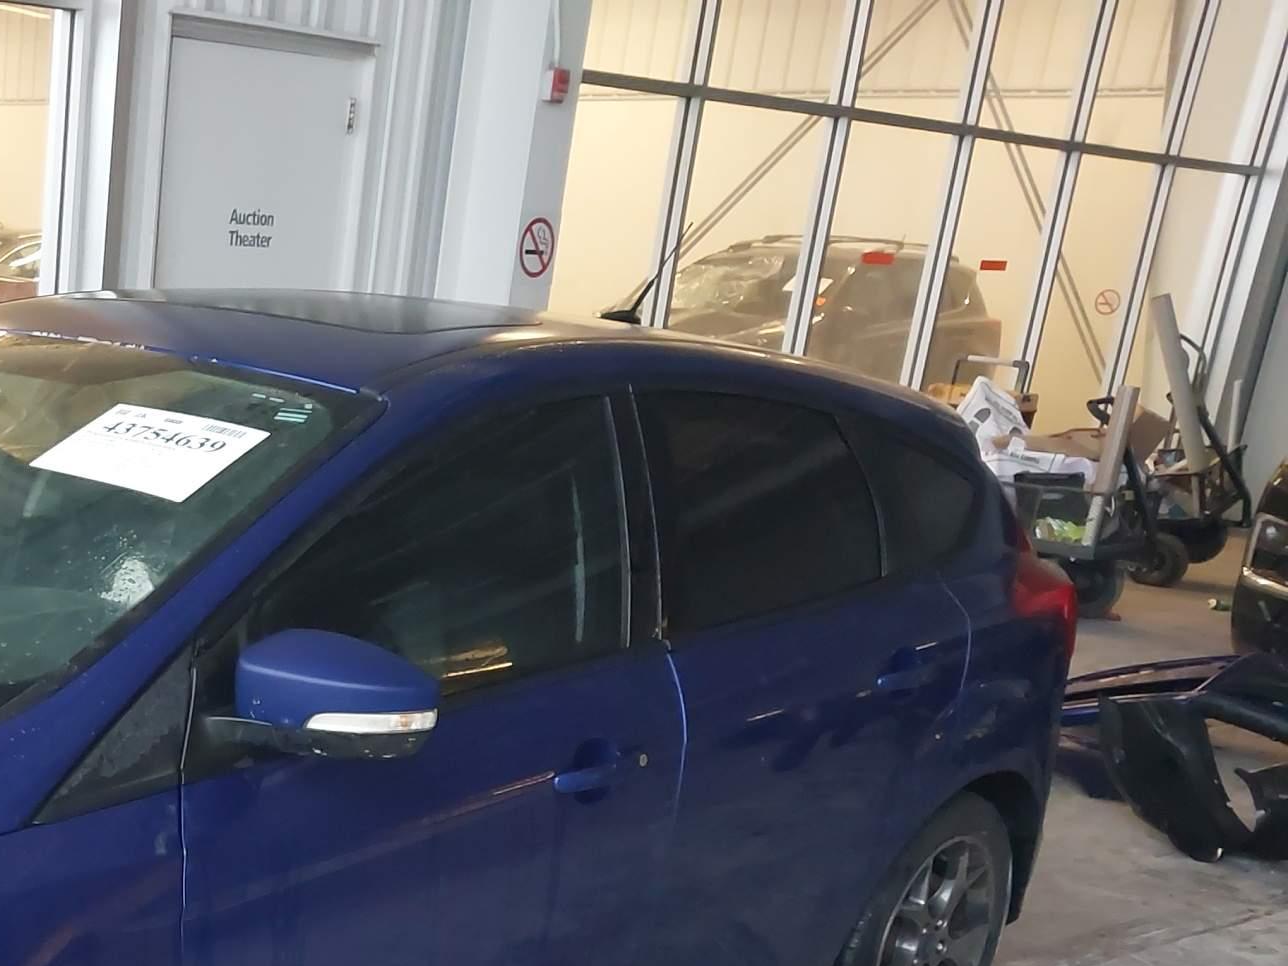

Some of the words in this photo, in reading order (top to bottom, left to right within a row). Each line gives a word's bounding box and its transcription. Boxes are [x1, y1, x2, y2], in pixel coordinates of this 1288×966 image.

[229, 208, 274, 226] Auction
[228, 229, 273, 248] Theater
[103, 420, 227, 453] 43754639
